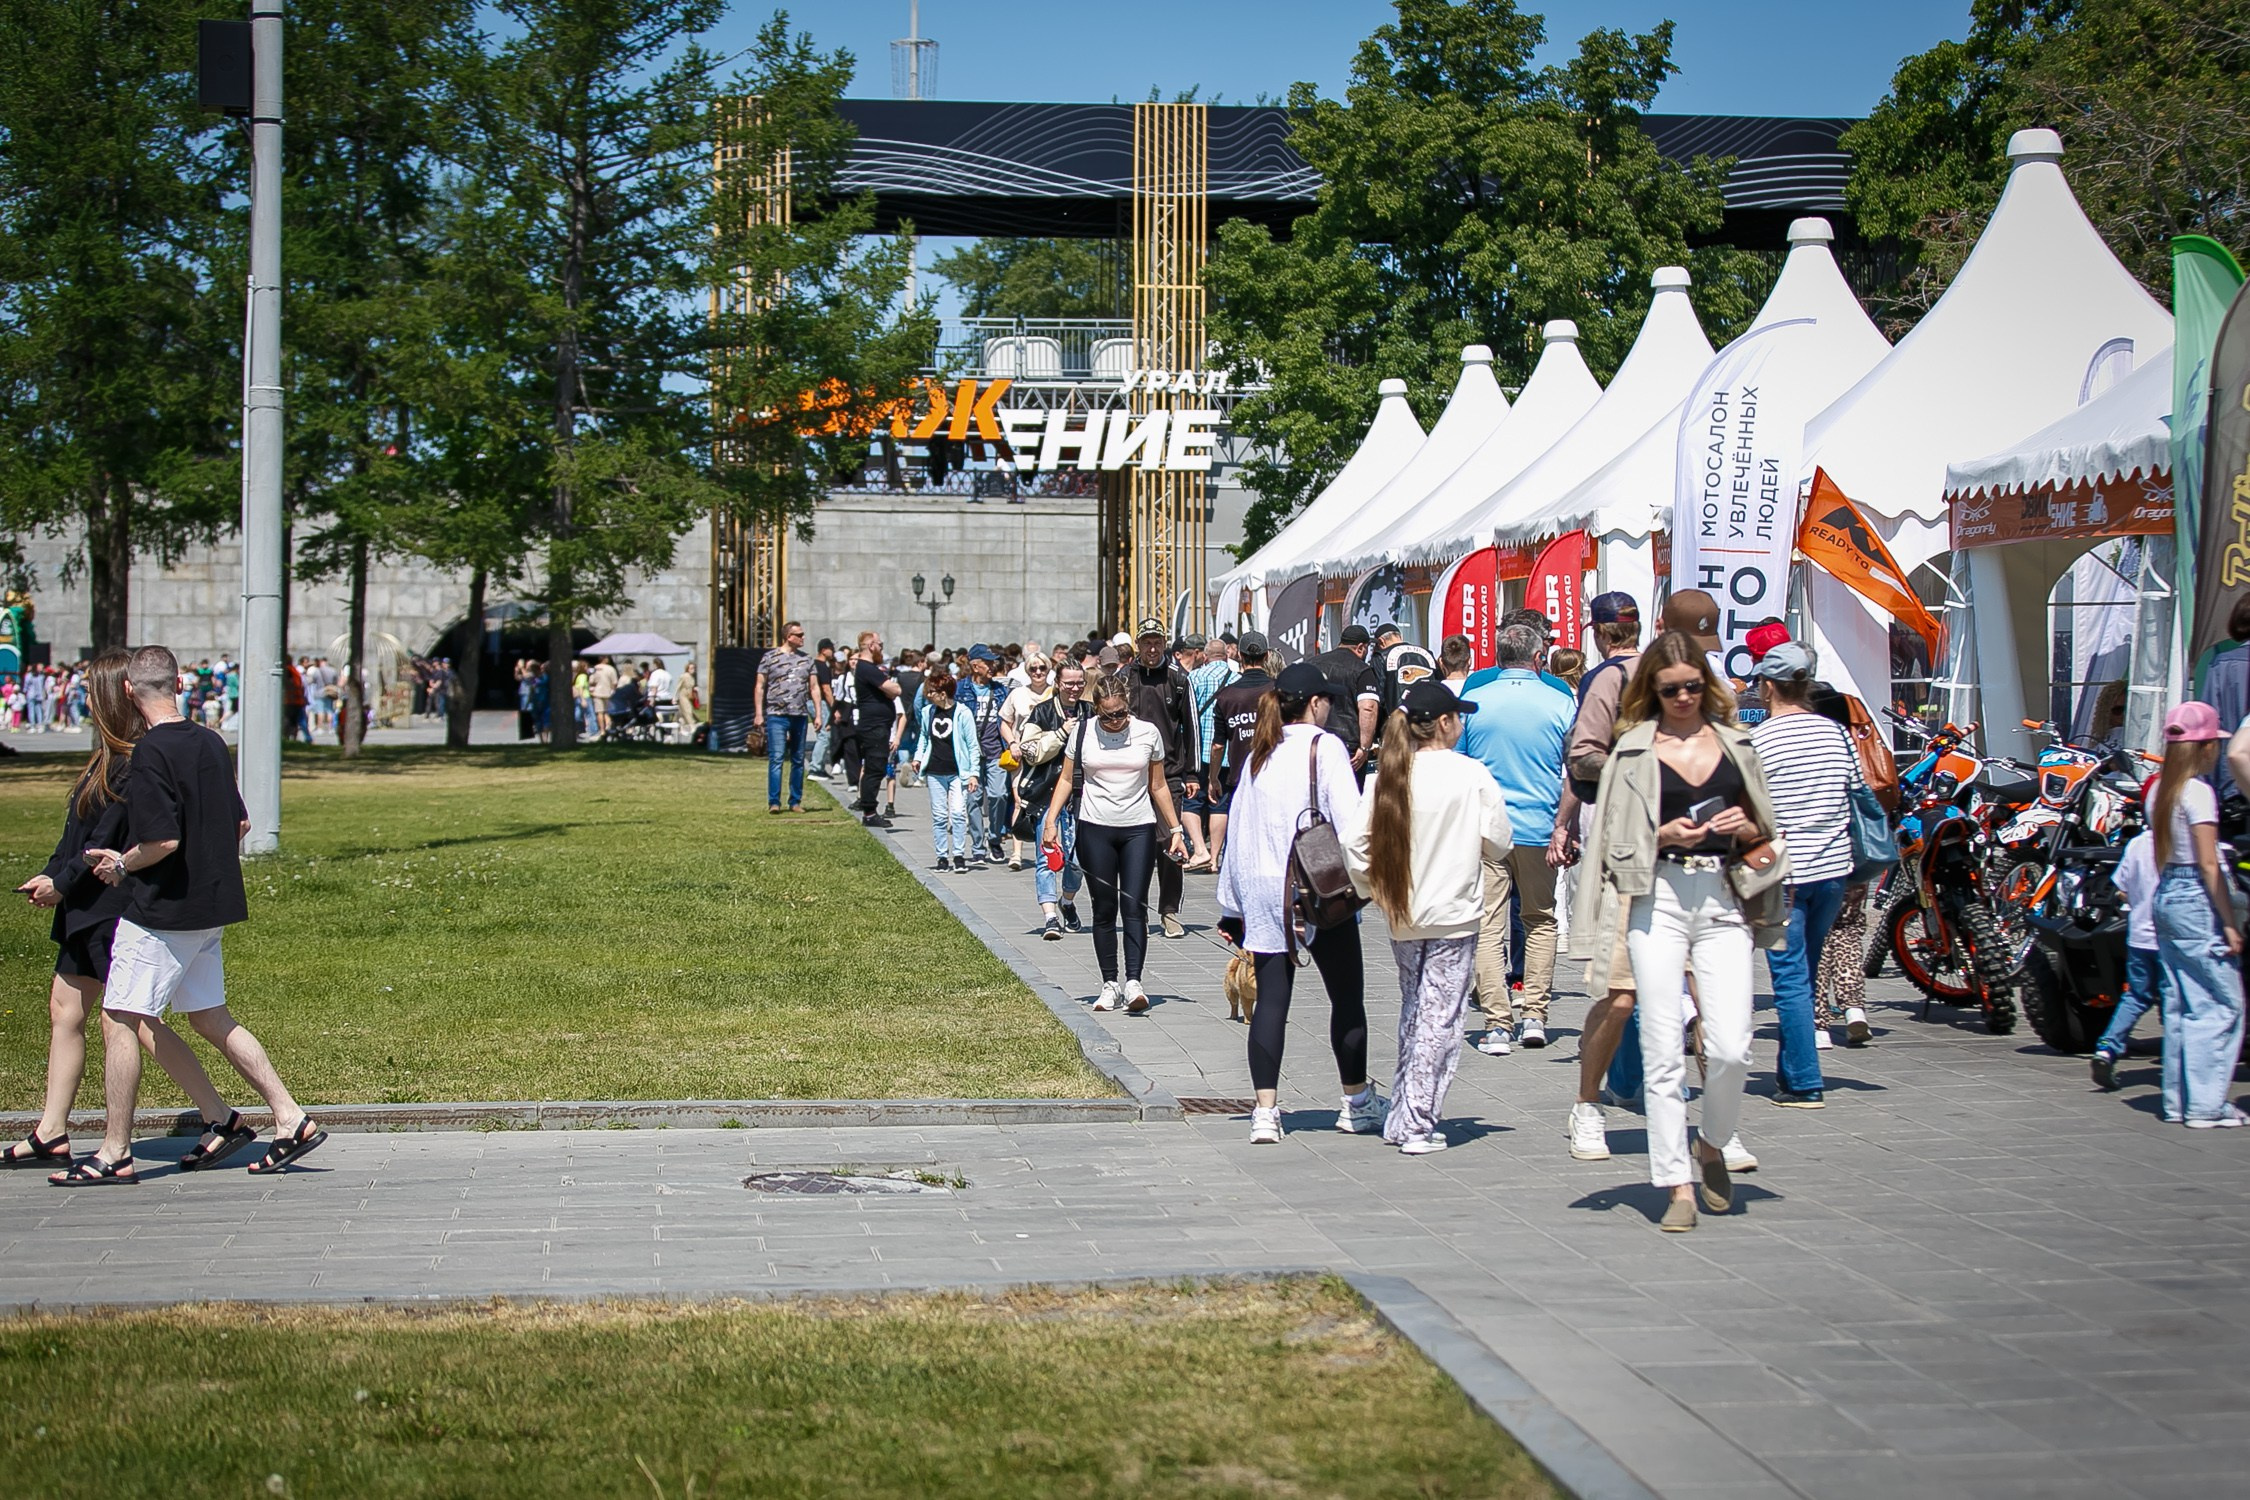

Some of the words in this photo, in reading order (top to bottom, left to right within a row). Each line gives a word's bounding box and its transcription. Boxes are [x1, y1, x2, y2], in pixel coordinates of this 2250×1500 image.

[1118, 369, 1229, 394] УРАЛ
[1701, 391, 1730, 537] МОТОСАЛОН
[1728, 385, 1760, 539] УВЛЕЧЁННЫХ
[1756, 458, 1780, 541] ЛЮДЕЙ
[2132, 506, 2175, 521] Dragon
[1808, 525, 1853, 553] READY
[1853, 552, 1869, 570] TO
[1956, 522, 1997, 538] Dragonfly
[1480, 584, 1489, 657] FORWARD
[1724, 566, 1767, 685] ОТО
[1228, 711, 1257, 728] SECU
